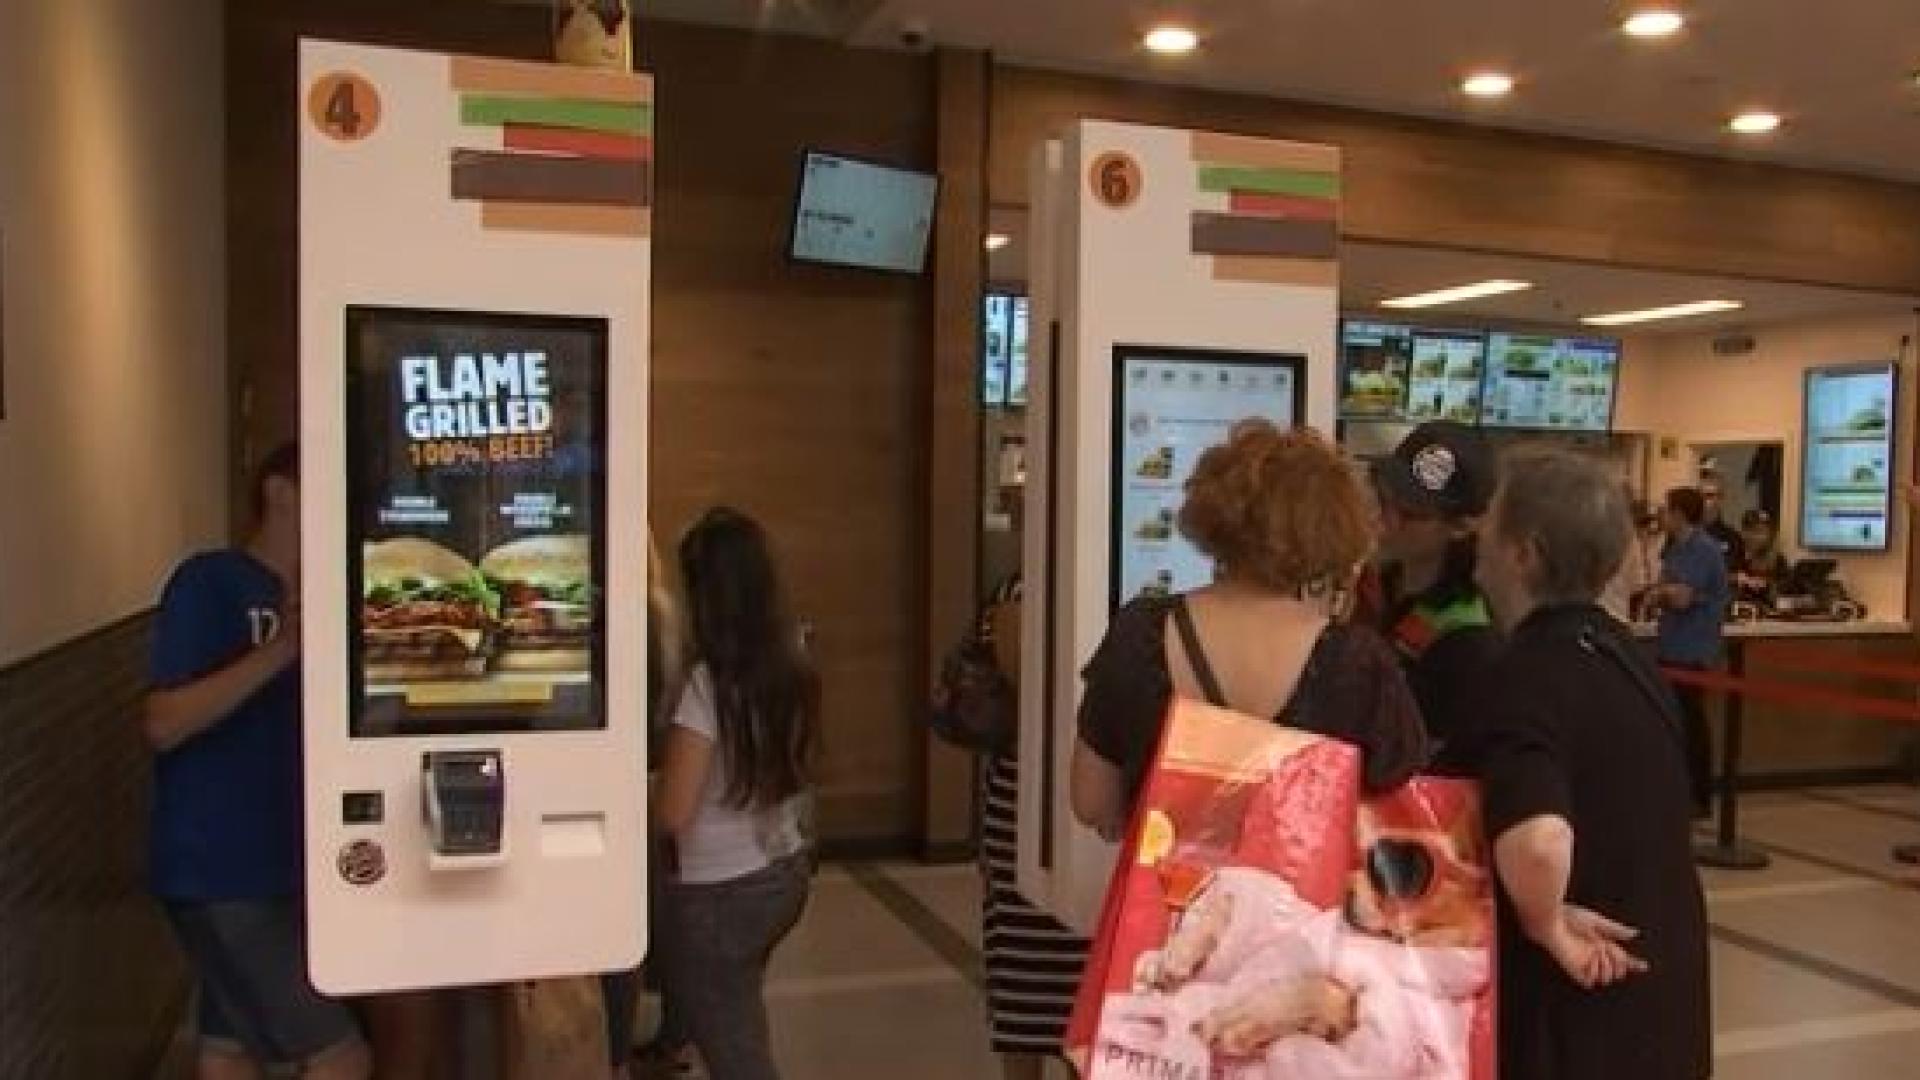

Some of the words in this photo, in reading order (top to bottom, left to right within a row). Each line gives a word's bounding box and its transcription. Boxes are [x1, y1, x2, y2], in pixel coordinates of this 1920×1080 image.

[325, 80, 360, 135] 4
[1101, 160, 1129, 206] 6
[401, 352, 549, 402] FLAME
[406, 400, 553, 439] GRILLED
[408, 440, 480, 465] 100%
